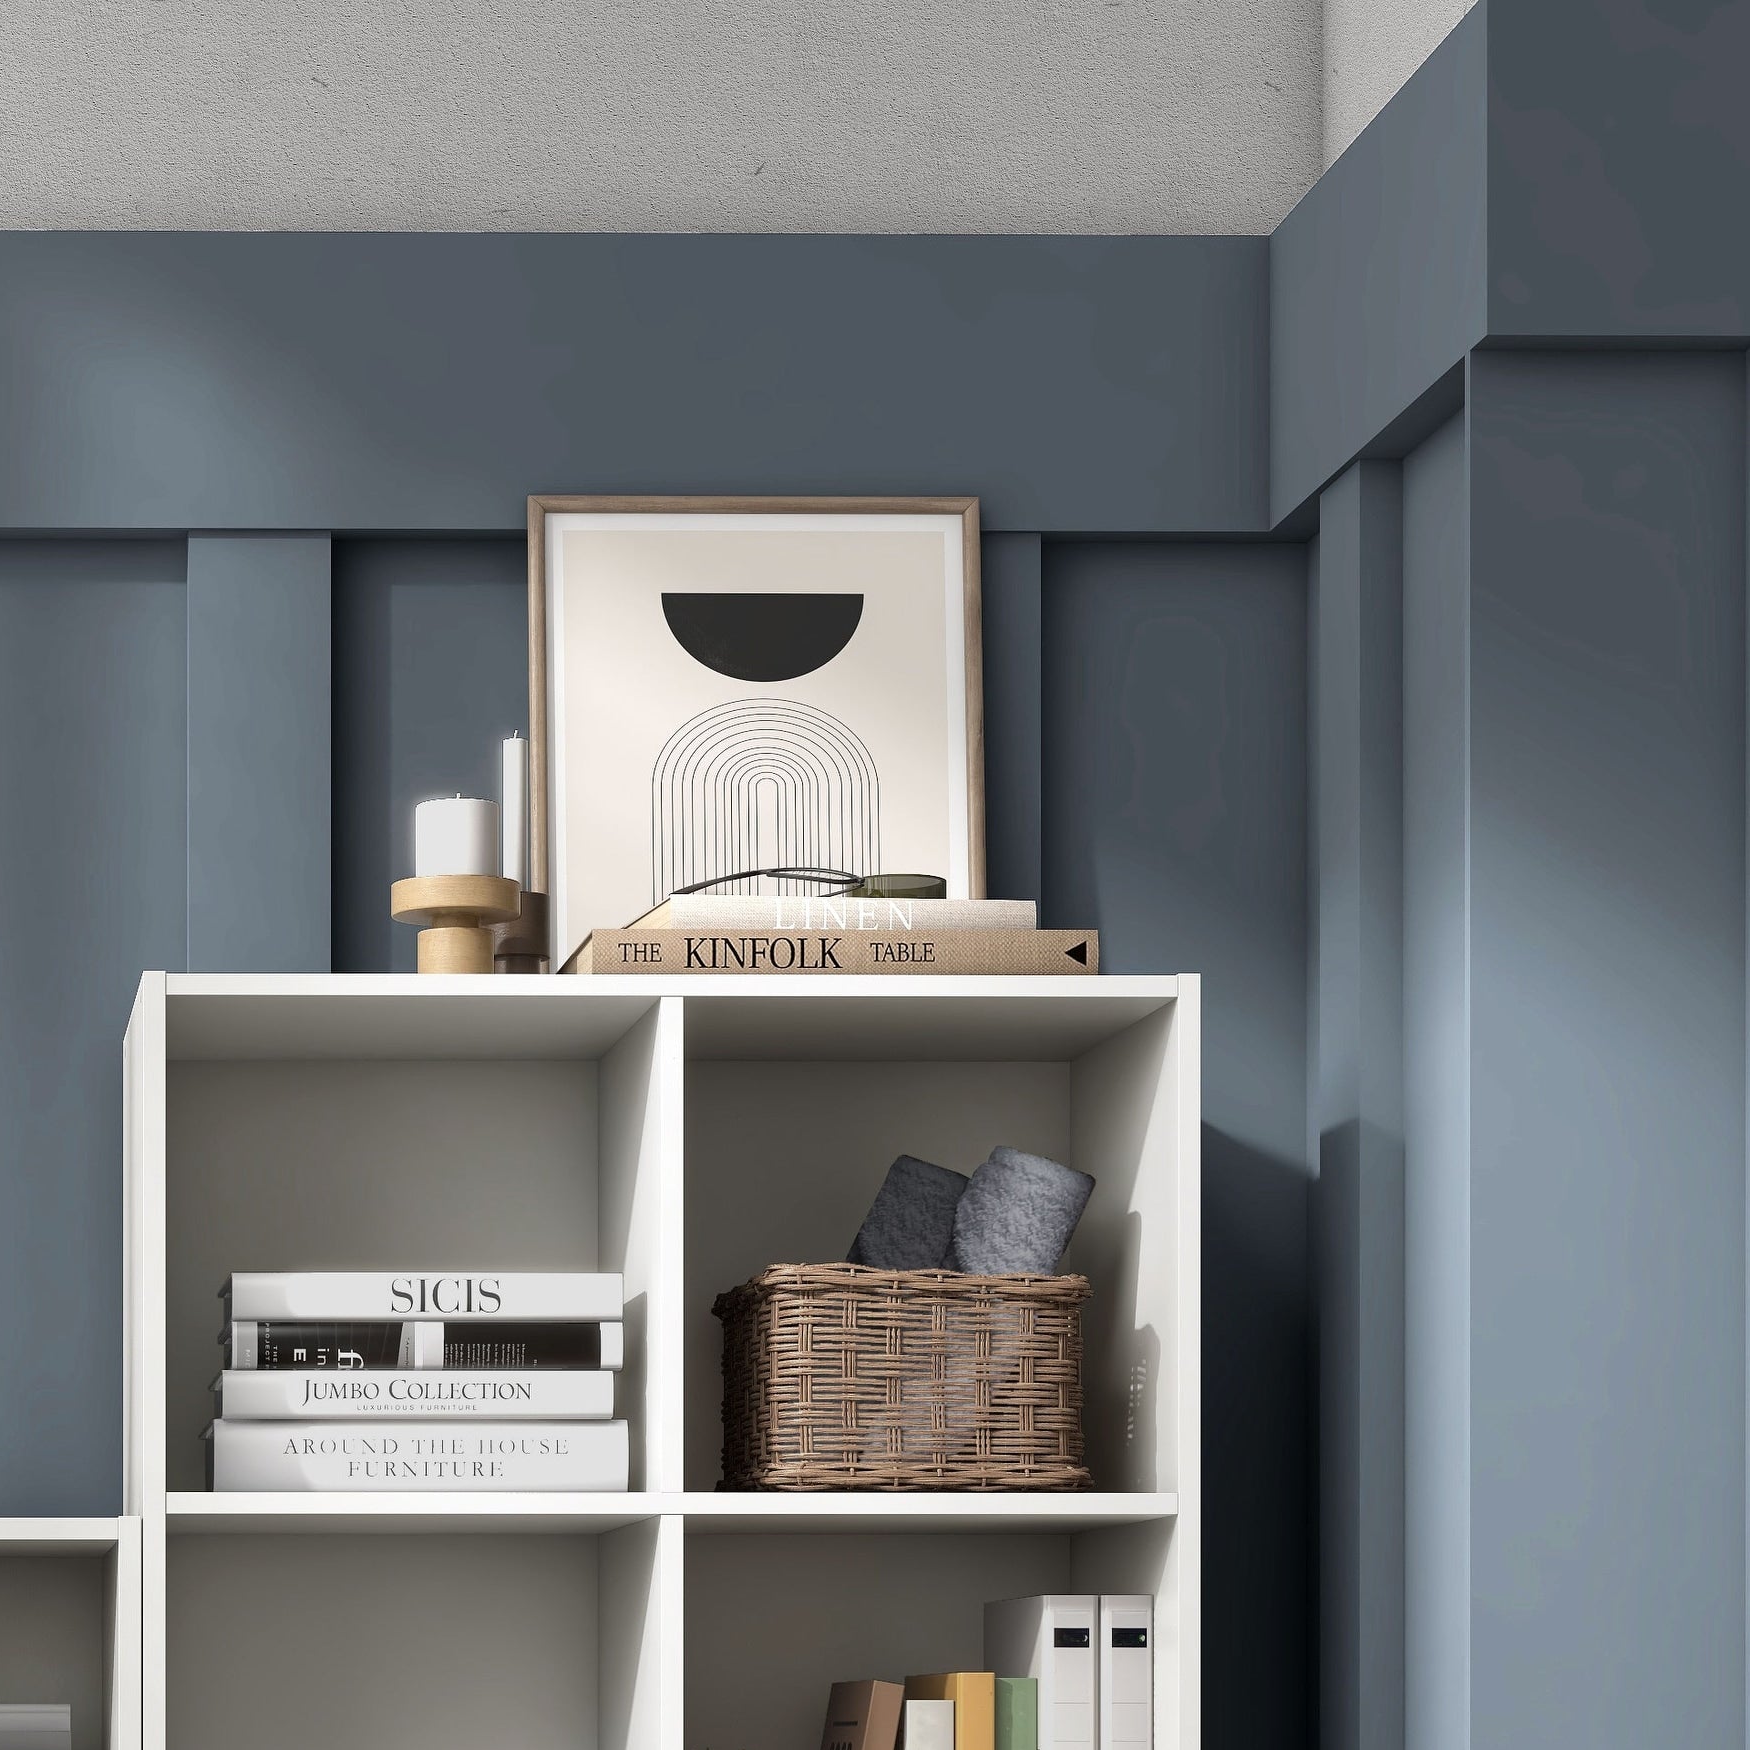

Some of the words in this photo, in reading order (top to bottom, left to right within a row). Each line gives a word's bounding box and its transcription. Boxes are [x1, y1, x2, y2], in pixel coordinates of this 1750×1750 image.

[773, 900, 914, 931] LINEN
[618, 942, 662, 963] THE
[683, 937, 843, 969] KINFOLK
[870, 942, 936, 963] TABLE
[390, 1278, 502, 1314] SICIS
[302, 1379, 380, 1406] JUMBO
[388, 1379, 532, 1400] COLLECTION
[282, 1438, 398, 1454] AROUND
[412, 1438, 465, 1454] THE
[479, 1438, 569, 1454] HOUSE
[347, 1461, 504, 1478] FURNITURE
